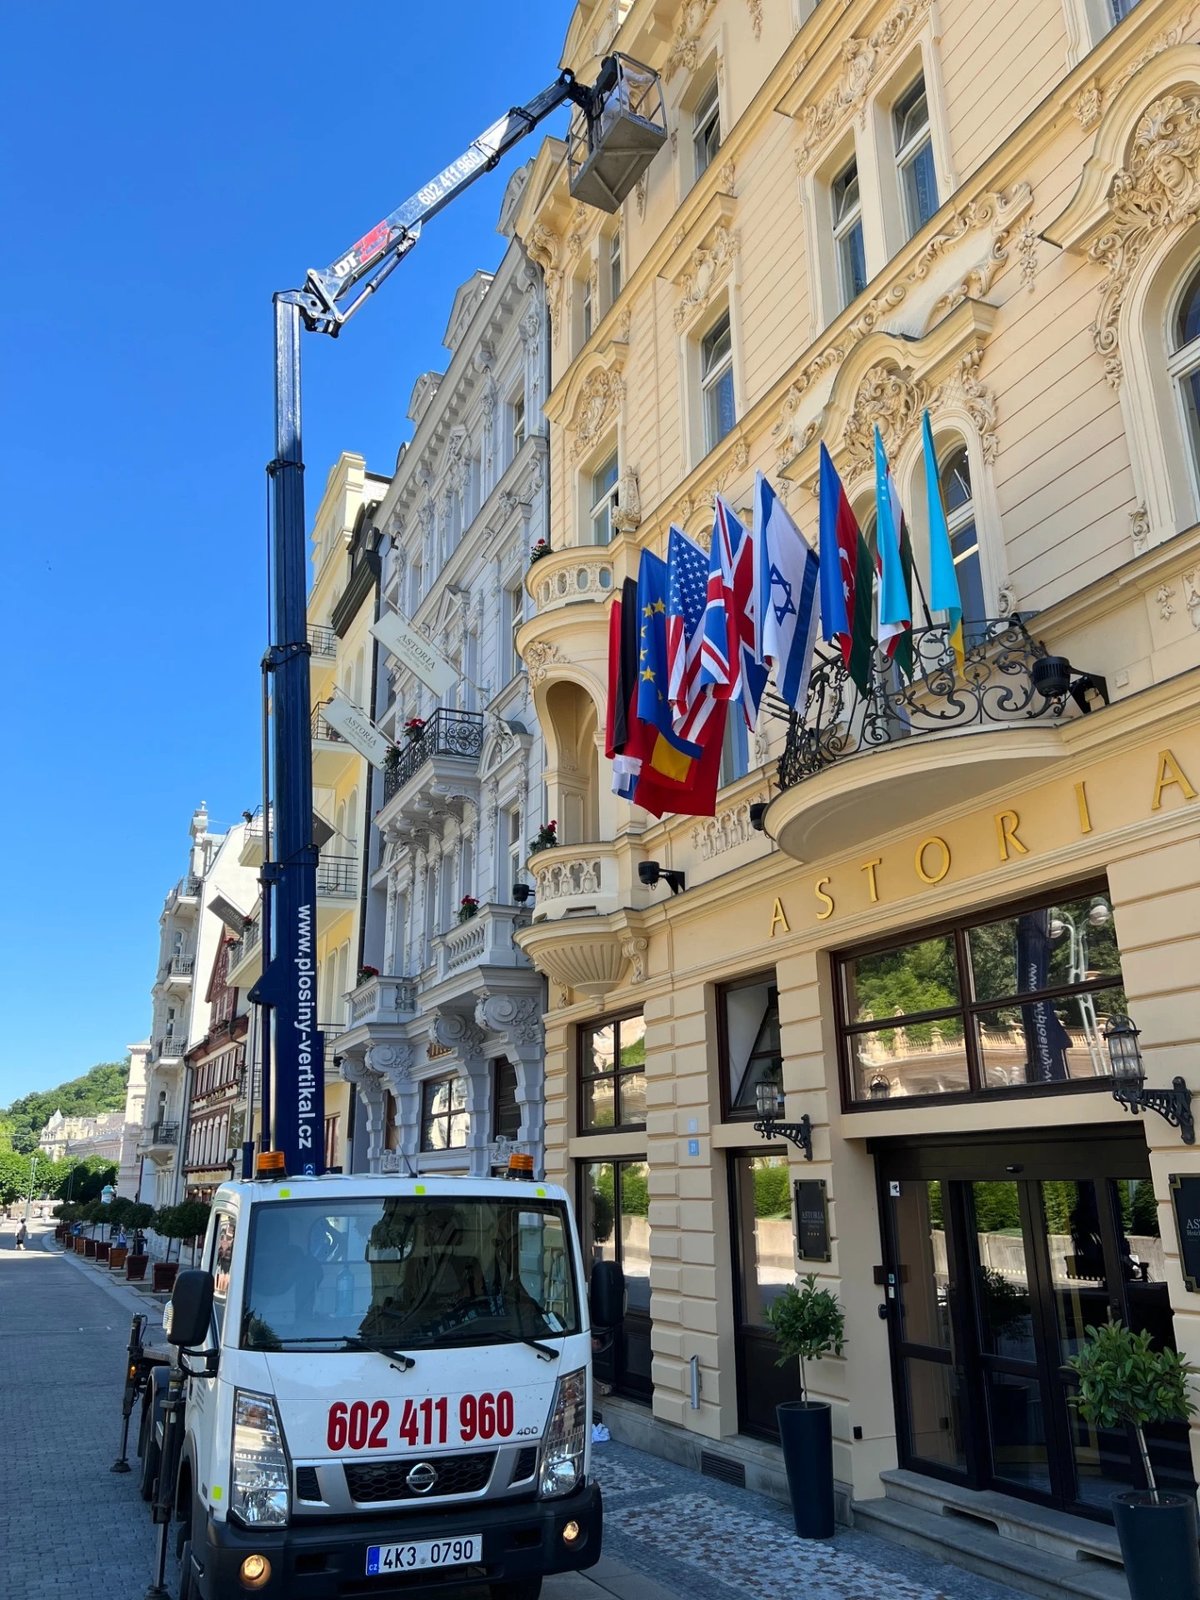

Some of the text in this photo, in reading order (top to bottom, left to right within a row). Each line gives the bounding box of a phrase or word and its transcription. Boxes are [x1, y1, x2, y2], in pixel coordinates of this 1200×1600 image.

[418, 151, 481, 206] 602 411 960
[400, 634, 436, 669] ASTORIA
[345, 716, 377, 746] ASTORIA
[768, 748, 1198, 937] ASTORIA
[294, 904, 316, 1149] www.plosiny-vertikal.cz
[1186, 1218, 1200, 1230] AS
[327, 1390, 514, 1451] 602 411 960
[516, 1426, 539, 1436] 400
[383, 1540, 473, 1569] 4K3 0790
